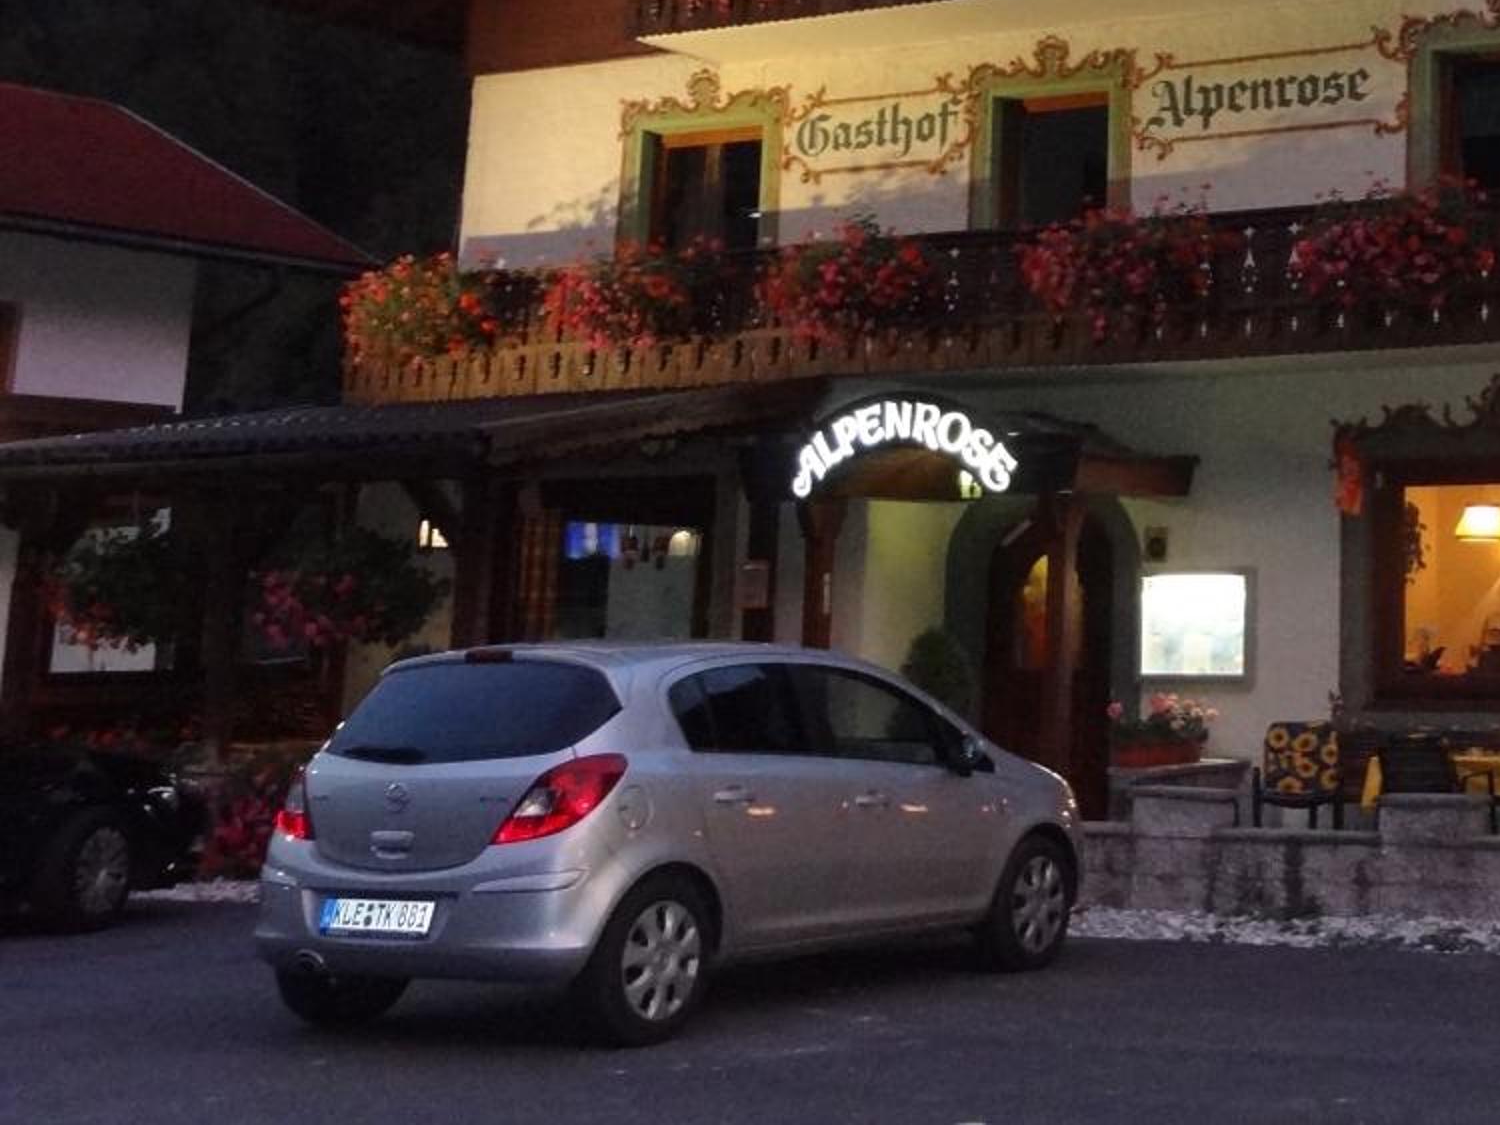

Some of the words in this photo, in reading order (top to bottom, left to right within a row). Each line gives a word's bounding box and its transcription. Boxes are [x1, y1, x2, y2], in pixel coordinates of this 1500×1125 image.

[796, 100, 961, 159] Gasthof
[1147, 67, 1369, 132] Alpenrose
[791, 400, 1018, 499] ALPENROSE
